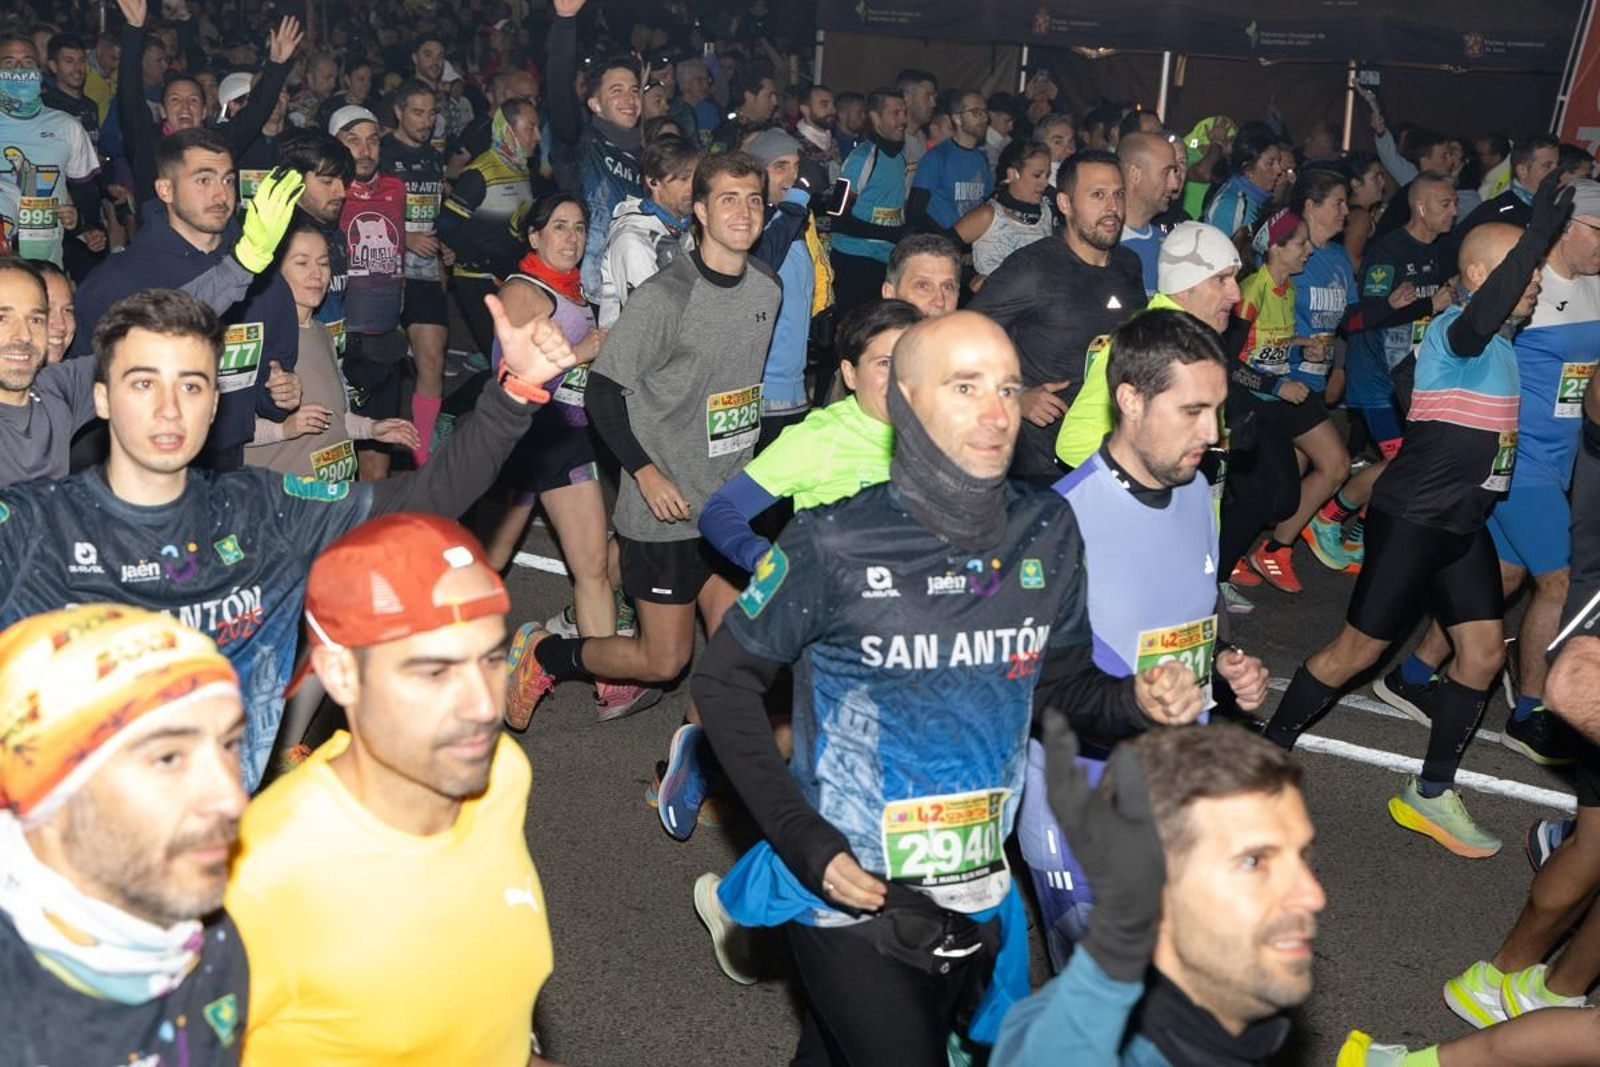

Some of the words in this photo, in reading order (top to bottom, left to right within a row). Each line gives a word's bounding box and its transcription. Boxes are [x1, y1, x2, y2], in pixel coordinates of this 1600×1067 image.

[219, 343, 257, 369] 77
[712, 402, 758, 434] 2326
[320, 457, 353, 484] 2907
[860, 634, 939, 670] SAN
[949, 617, 1051, 669] ANTÓN
[897, 821, 996, 877] 2940
